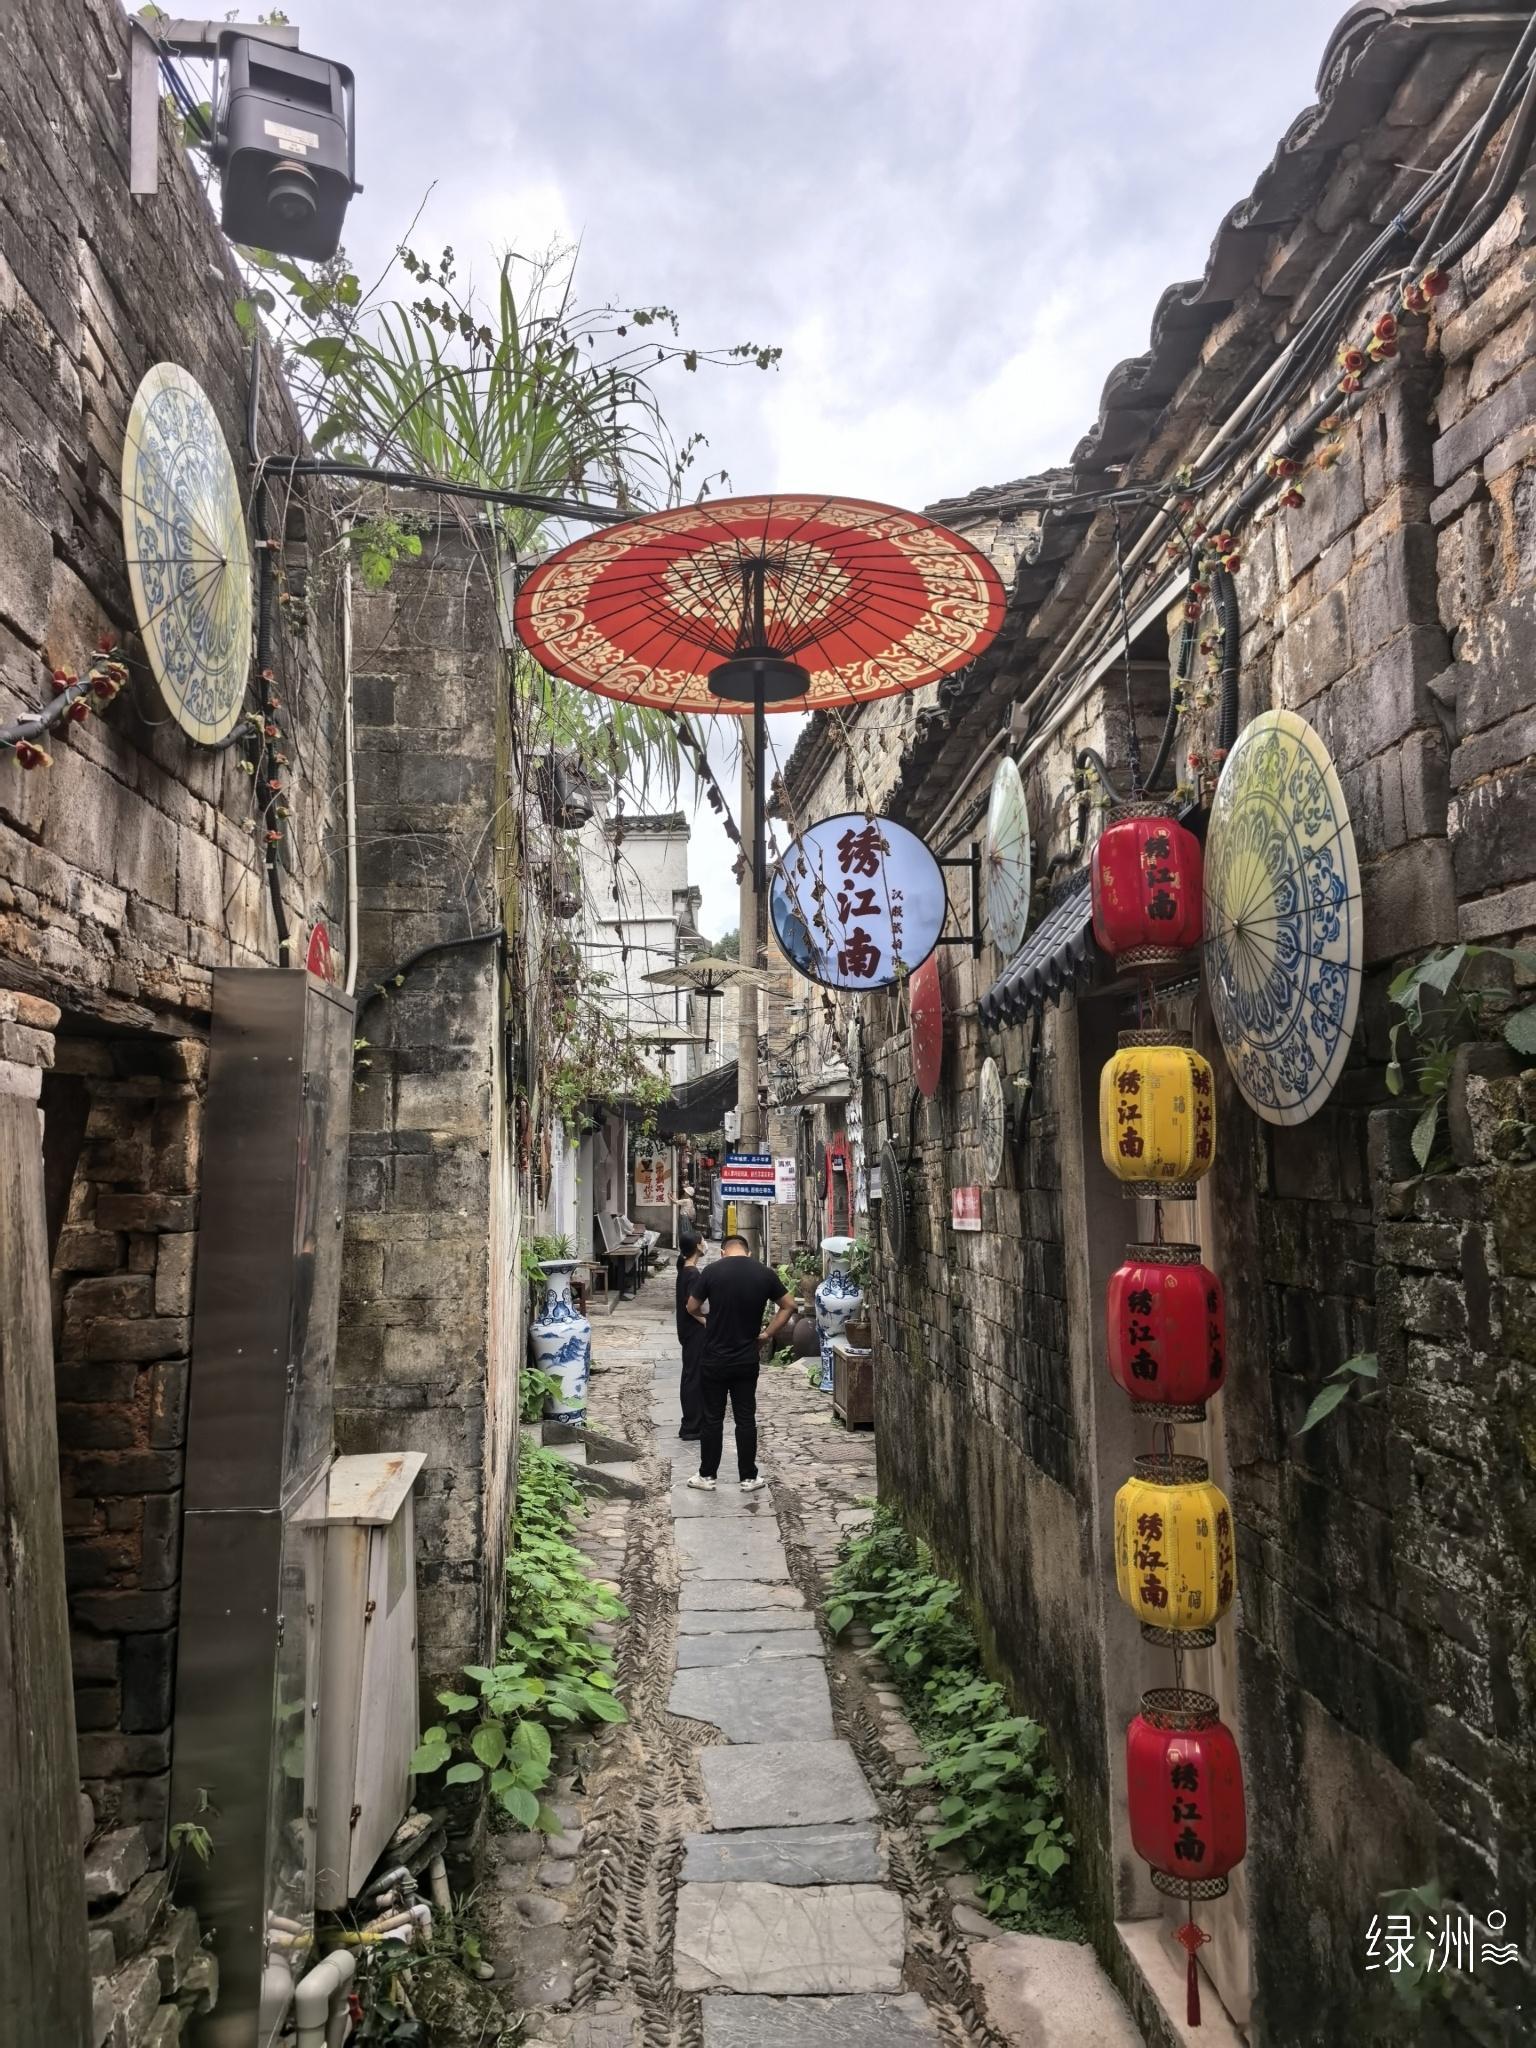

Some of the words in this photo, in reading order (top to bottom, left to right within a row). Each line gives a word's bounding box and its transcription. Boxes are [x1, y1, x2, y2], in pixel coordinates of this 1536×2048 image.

[837, 826, 881, 978] 绣江南
[1145, 836, 1177, 920] 绣江南
[1117, 1069, 1144, 1158] 绣江南
[1128, 1288, 1158, 1381] 绣江南
[1137, 1513, 1168, 1609] 绣江南
[1171, 1763, 1206, 1863] 绣江南
